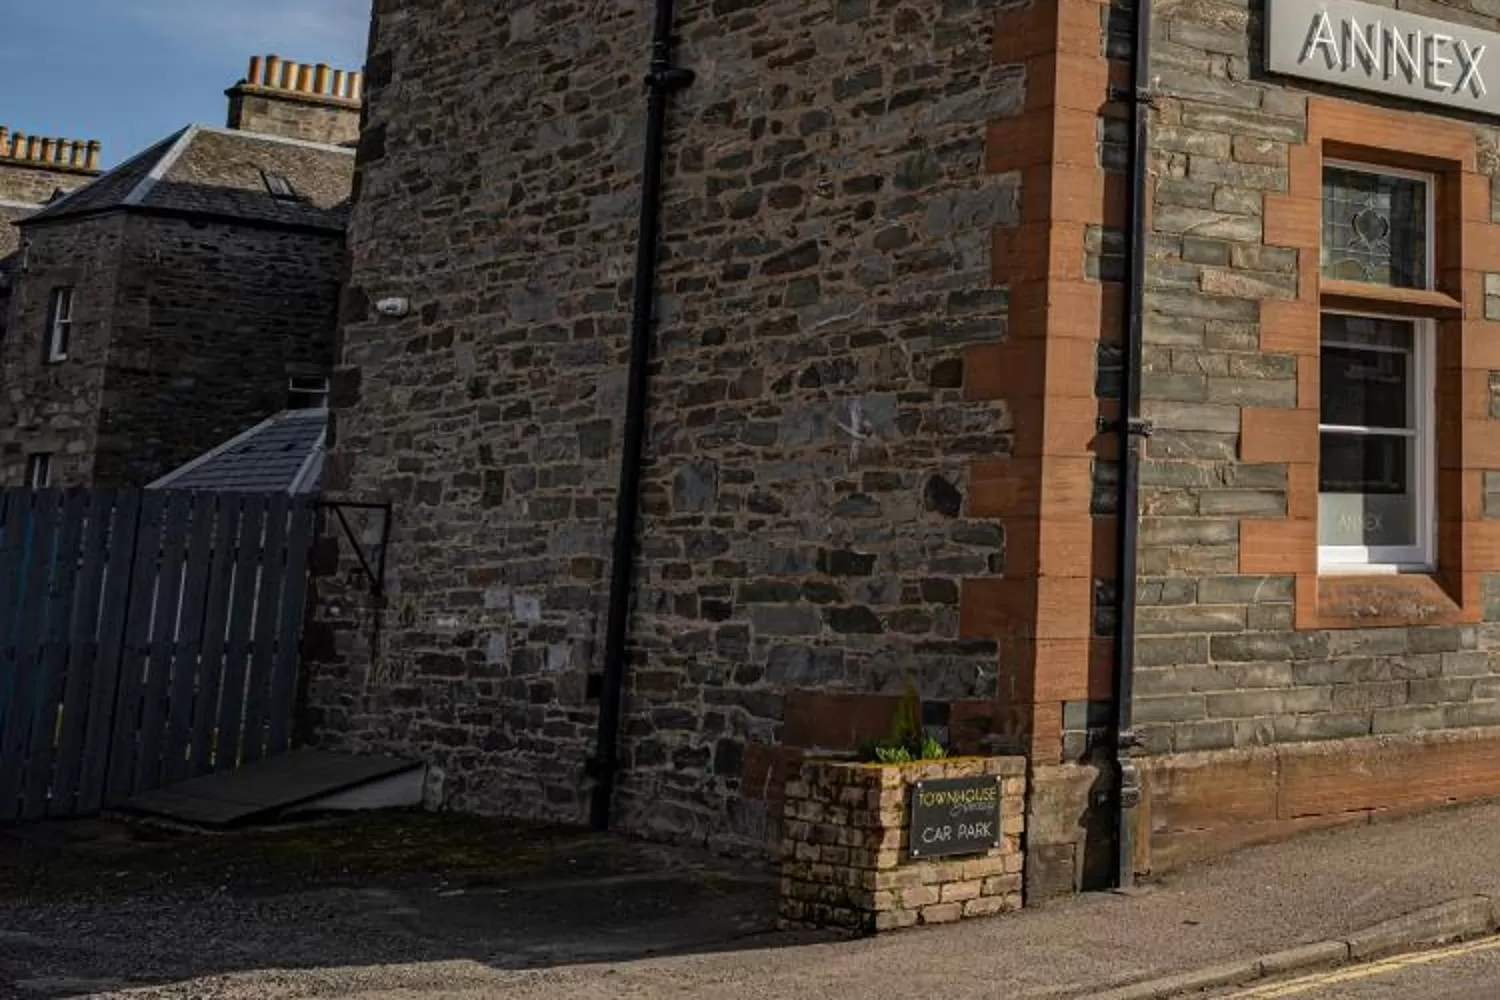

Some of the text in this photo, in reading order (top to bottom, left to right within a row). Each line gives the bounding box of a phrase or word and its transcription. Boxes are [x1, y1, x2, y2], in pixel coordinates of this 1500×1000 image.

[1305, 10, 1487, 96] ANNEX
[919, 787, 997, 808] TOWNHOUSE
[921, 821, 993, 843] CAR PARK
